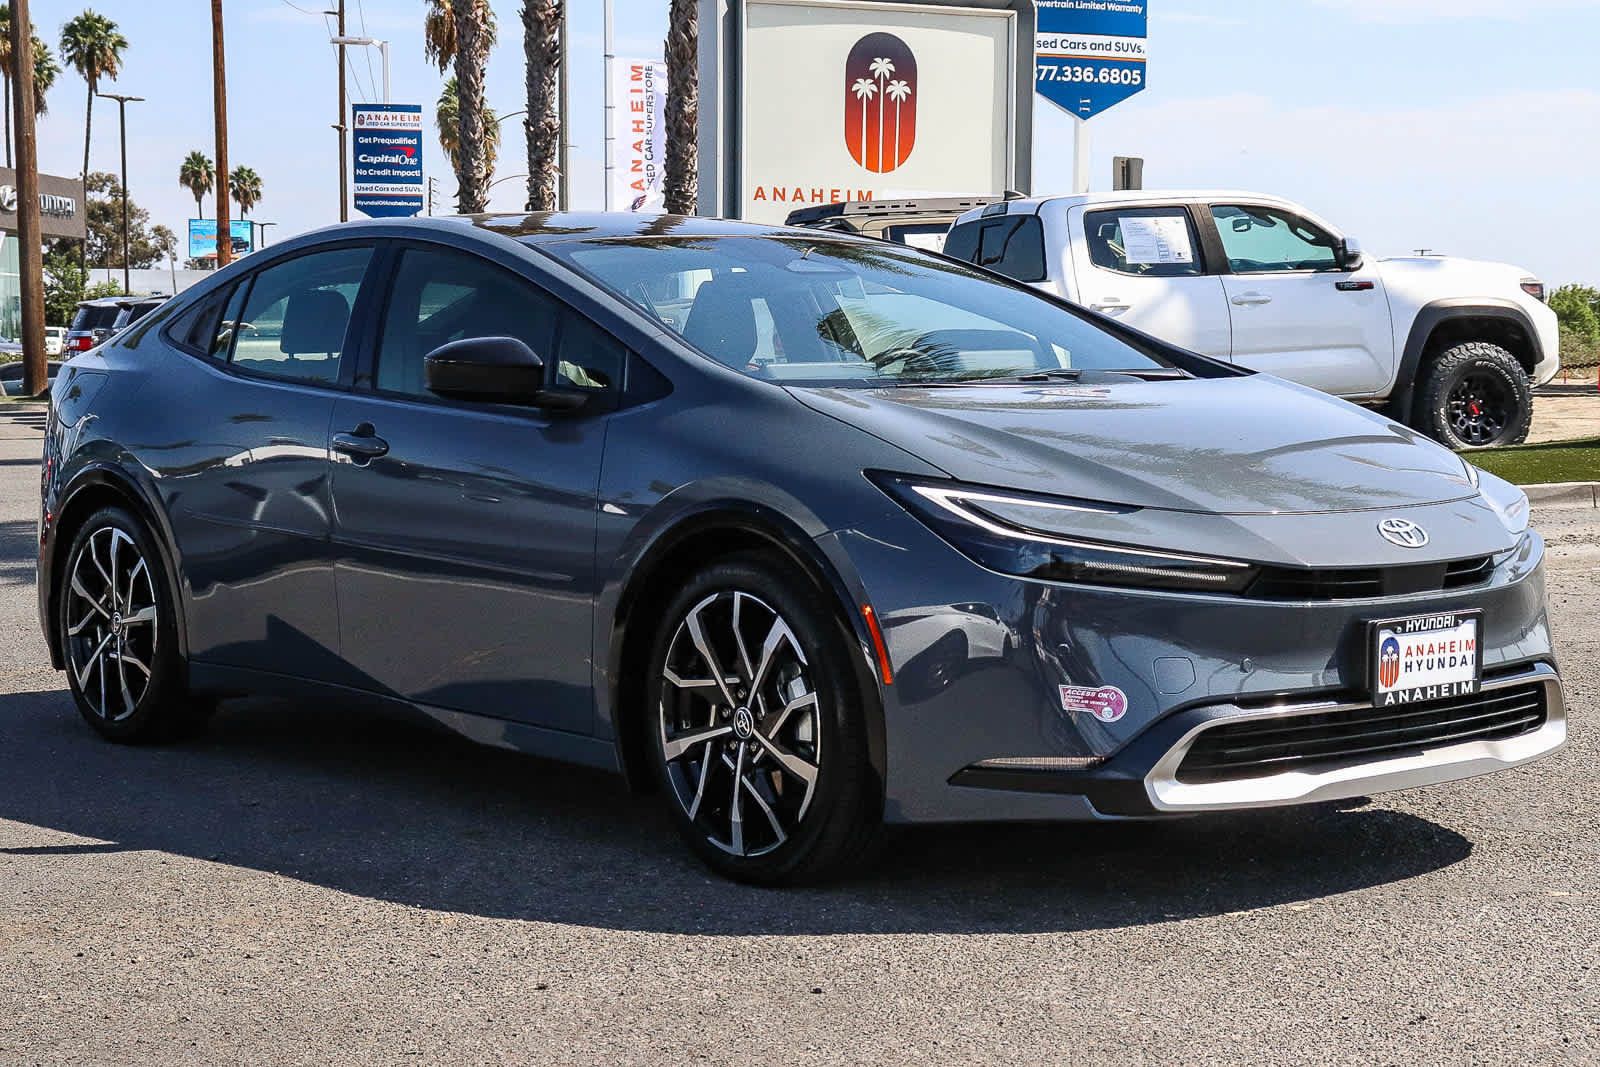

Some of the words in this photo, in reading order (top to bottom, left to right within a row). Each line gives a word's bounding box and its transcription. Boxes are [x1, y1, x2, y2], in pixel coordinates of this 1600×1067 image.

[1034, 0, 1074, 9] owertrain
[1075, 0, 1106, 10] Limited
[1106, 2, 1143, 14] Warranty
[1036, 38, 1058, 49] sed
[1060, 39, 1087, 50] Cars
[1089, 40, 1112, 52] and
[645, 65, 654, 135] SUPERSTORE
[366, 113, 420, 122] ANAHEIM
[630, 65, 645, 191] ANAHEIM
[358, 136, 373, 144] Get
[373, 136, 418, 145] Prequalified
[645, 138, 654, 161] CAR
[356, 168, 367, 176] No
[368, 168, 391, 176] Credit
[392, 169, 421, 177] Impact!
[646, 164, 656, 190] SED
[390, 185, 404, 193] and
[753, 186, 873, 203] ANAHEIM
[39, 193, 76, 213] UNDAI
[1405, 615, 1455, 632] HYUNDAI
[1405, 638, 1475, 658] ANAHEIM
[1404, 654, 1474, 673] HYUNDAI
[1065, 689, 1096, 697] ACCESS
[1384, 680, 1474, 705] ANAHEIM
